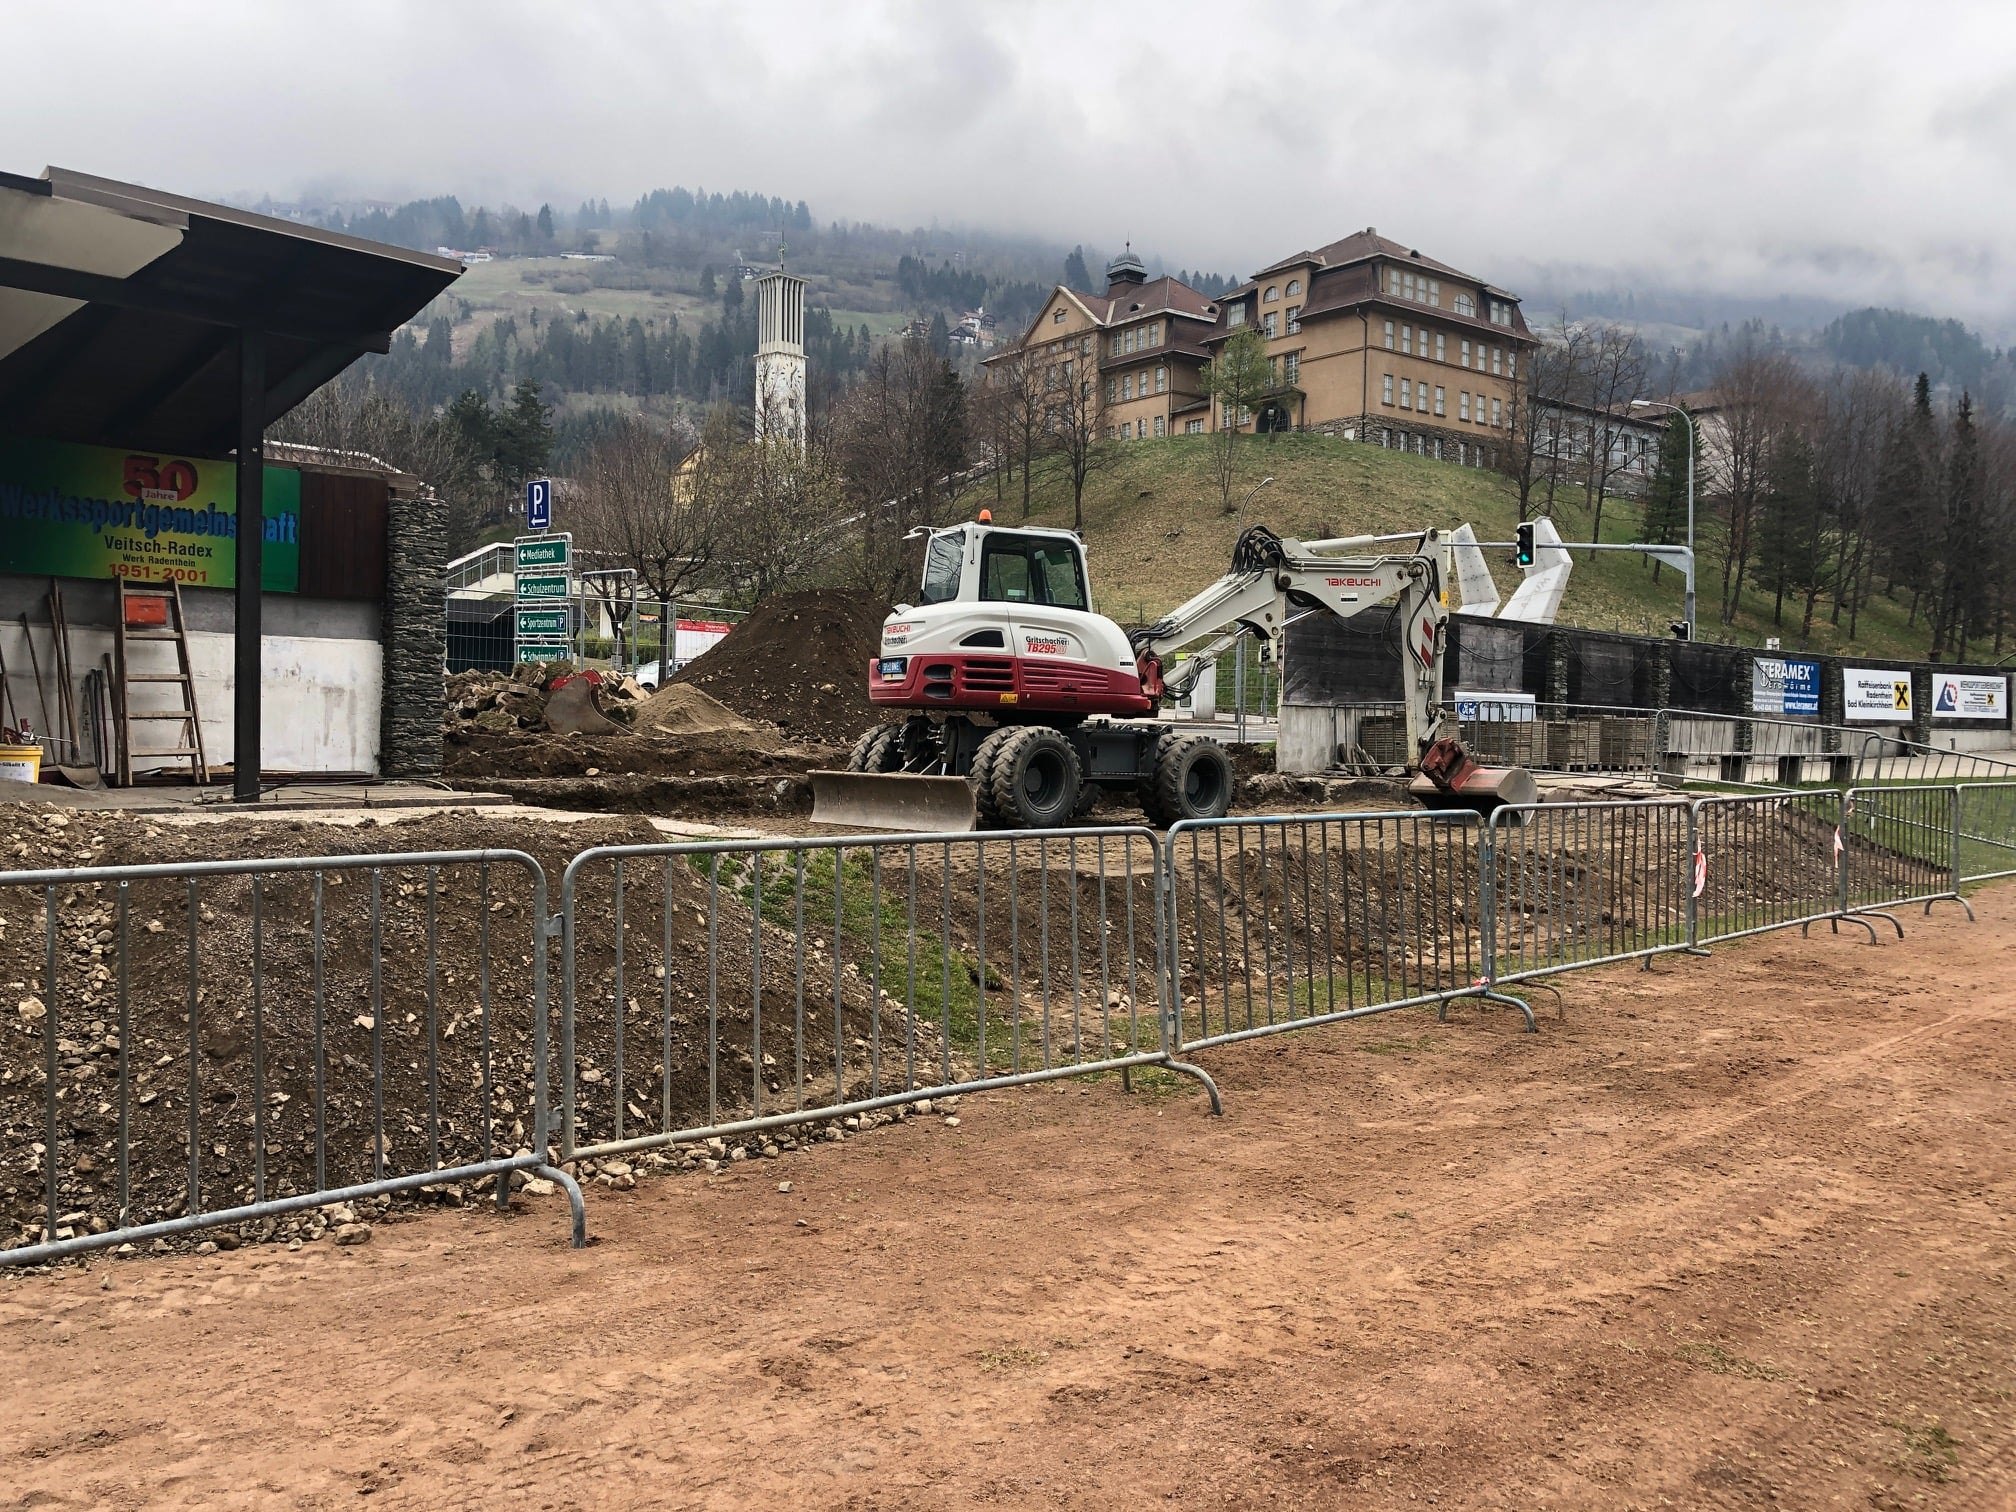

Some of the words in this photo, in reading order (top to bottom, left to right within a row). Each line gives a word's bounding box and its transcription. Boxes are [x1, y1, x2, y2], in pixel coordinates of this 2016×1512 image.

[123, 455, 199, 501] 50
[145, 490, 174, 501] Jahre
[533, 484, 543, 515] P
[0, 483, 298, 544] Werkssportgemeinsaft
[104, 535, 213, 558] Veitsch-Radex
[527, 548, 555, 560] Mediathek
[122, 553, 145, 564] Werk
[148, 555, 196, 568] Radenthein
[109, 563, 208, 583] 1951-2001
[527, 583, 566, 594] Schulzentrum
[527, 617, 557, 630] Sportzentrum
[559, 617, 564, 628] P
